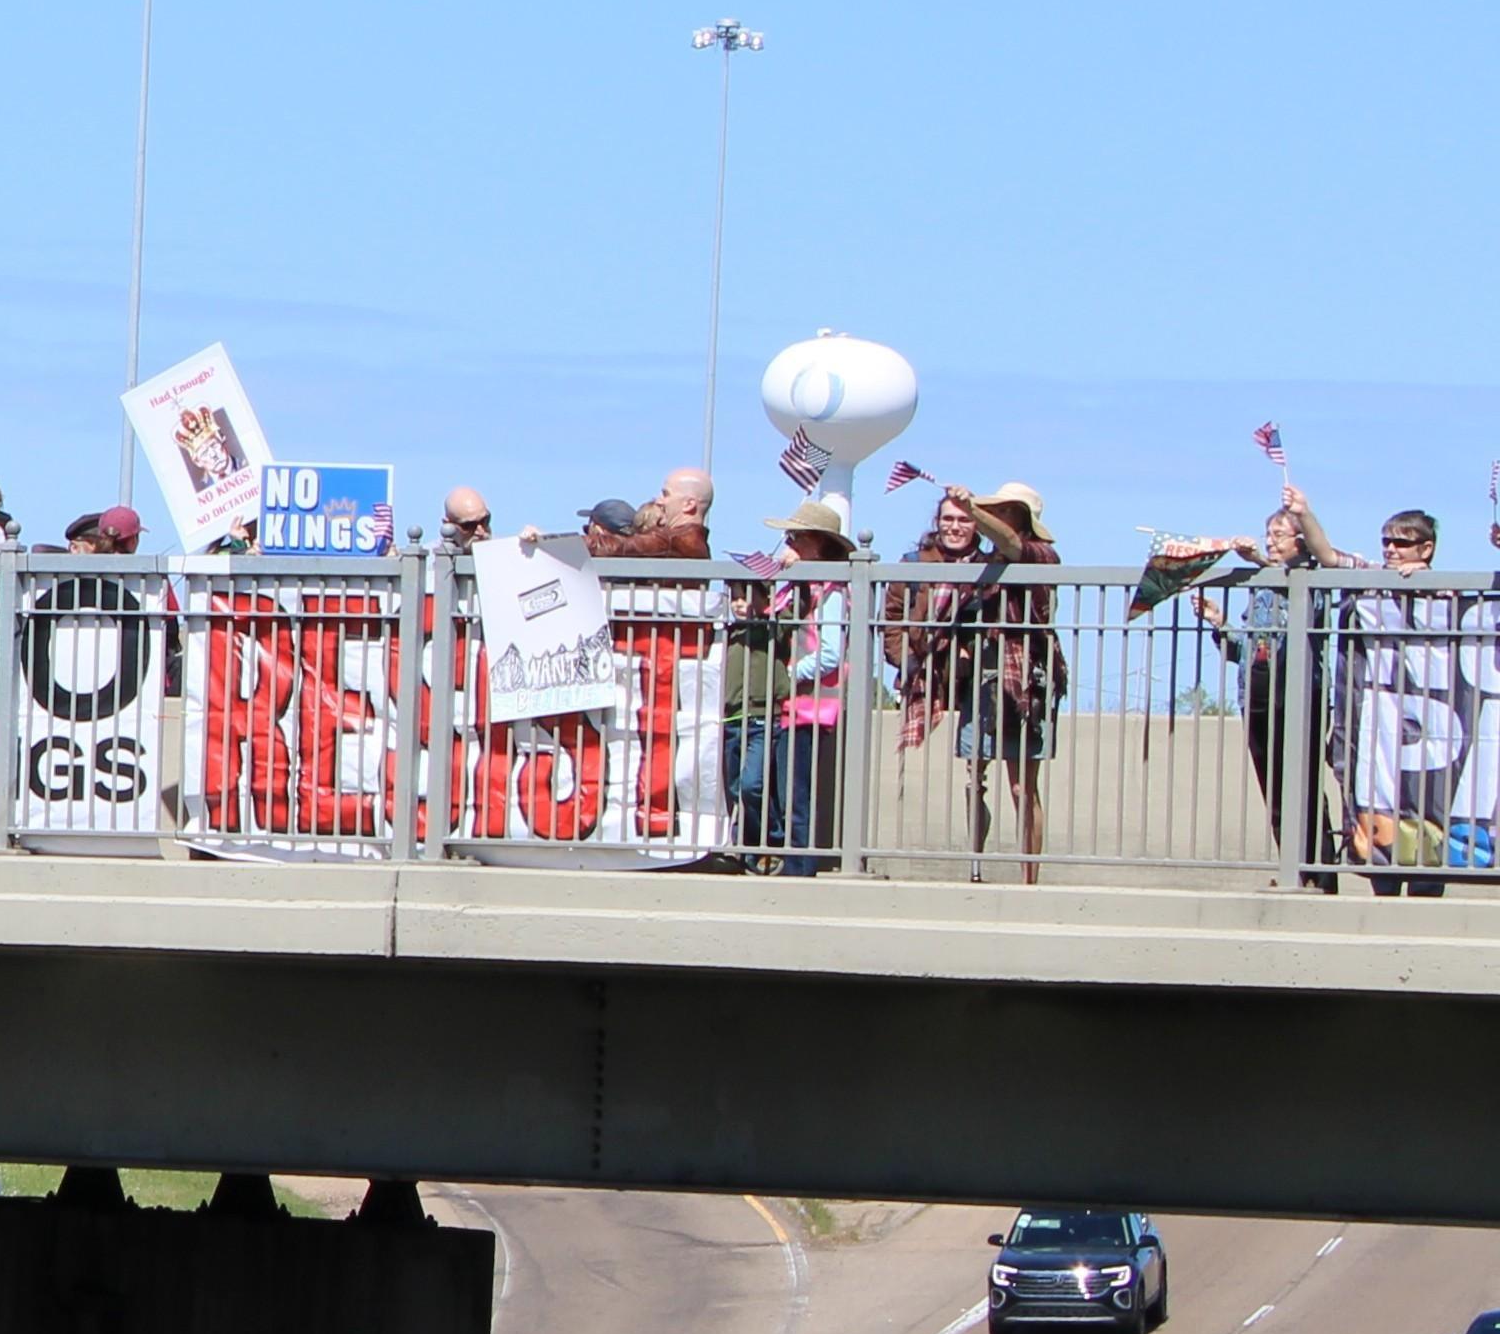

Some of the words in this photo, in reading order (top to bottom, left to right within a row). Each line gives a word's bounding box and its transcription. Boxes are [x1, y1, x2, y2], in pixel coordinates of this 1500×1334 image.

[150, 391, 171, 409] Had
[172, 366, 216, 397] Enough?
[196, 513, 211, 527] NO
[212, 485, 260, 517] DICTATOR
[197, 492, 214, 507] NO
[216, 470, 255, 497] KINGS!
[266, 468, 319, 510] NO
[264, 514, 376, 552] KINGS
[528, 652, 579, 689] WANT
